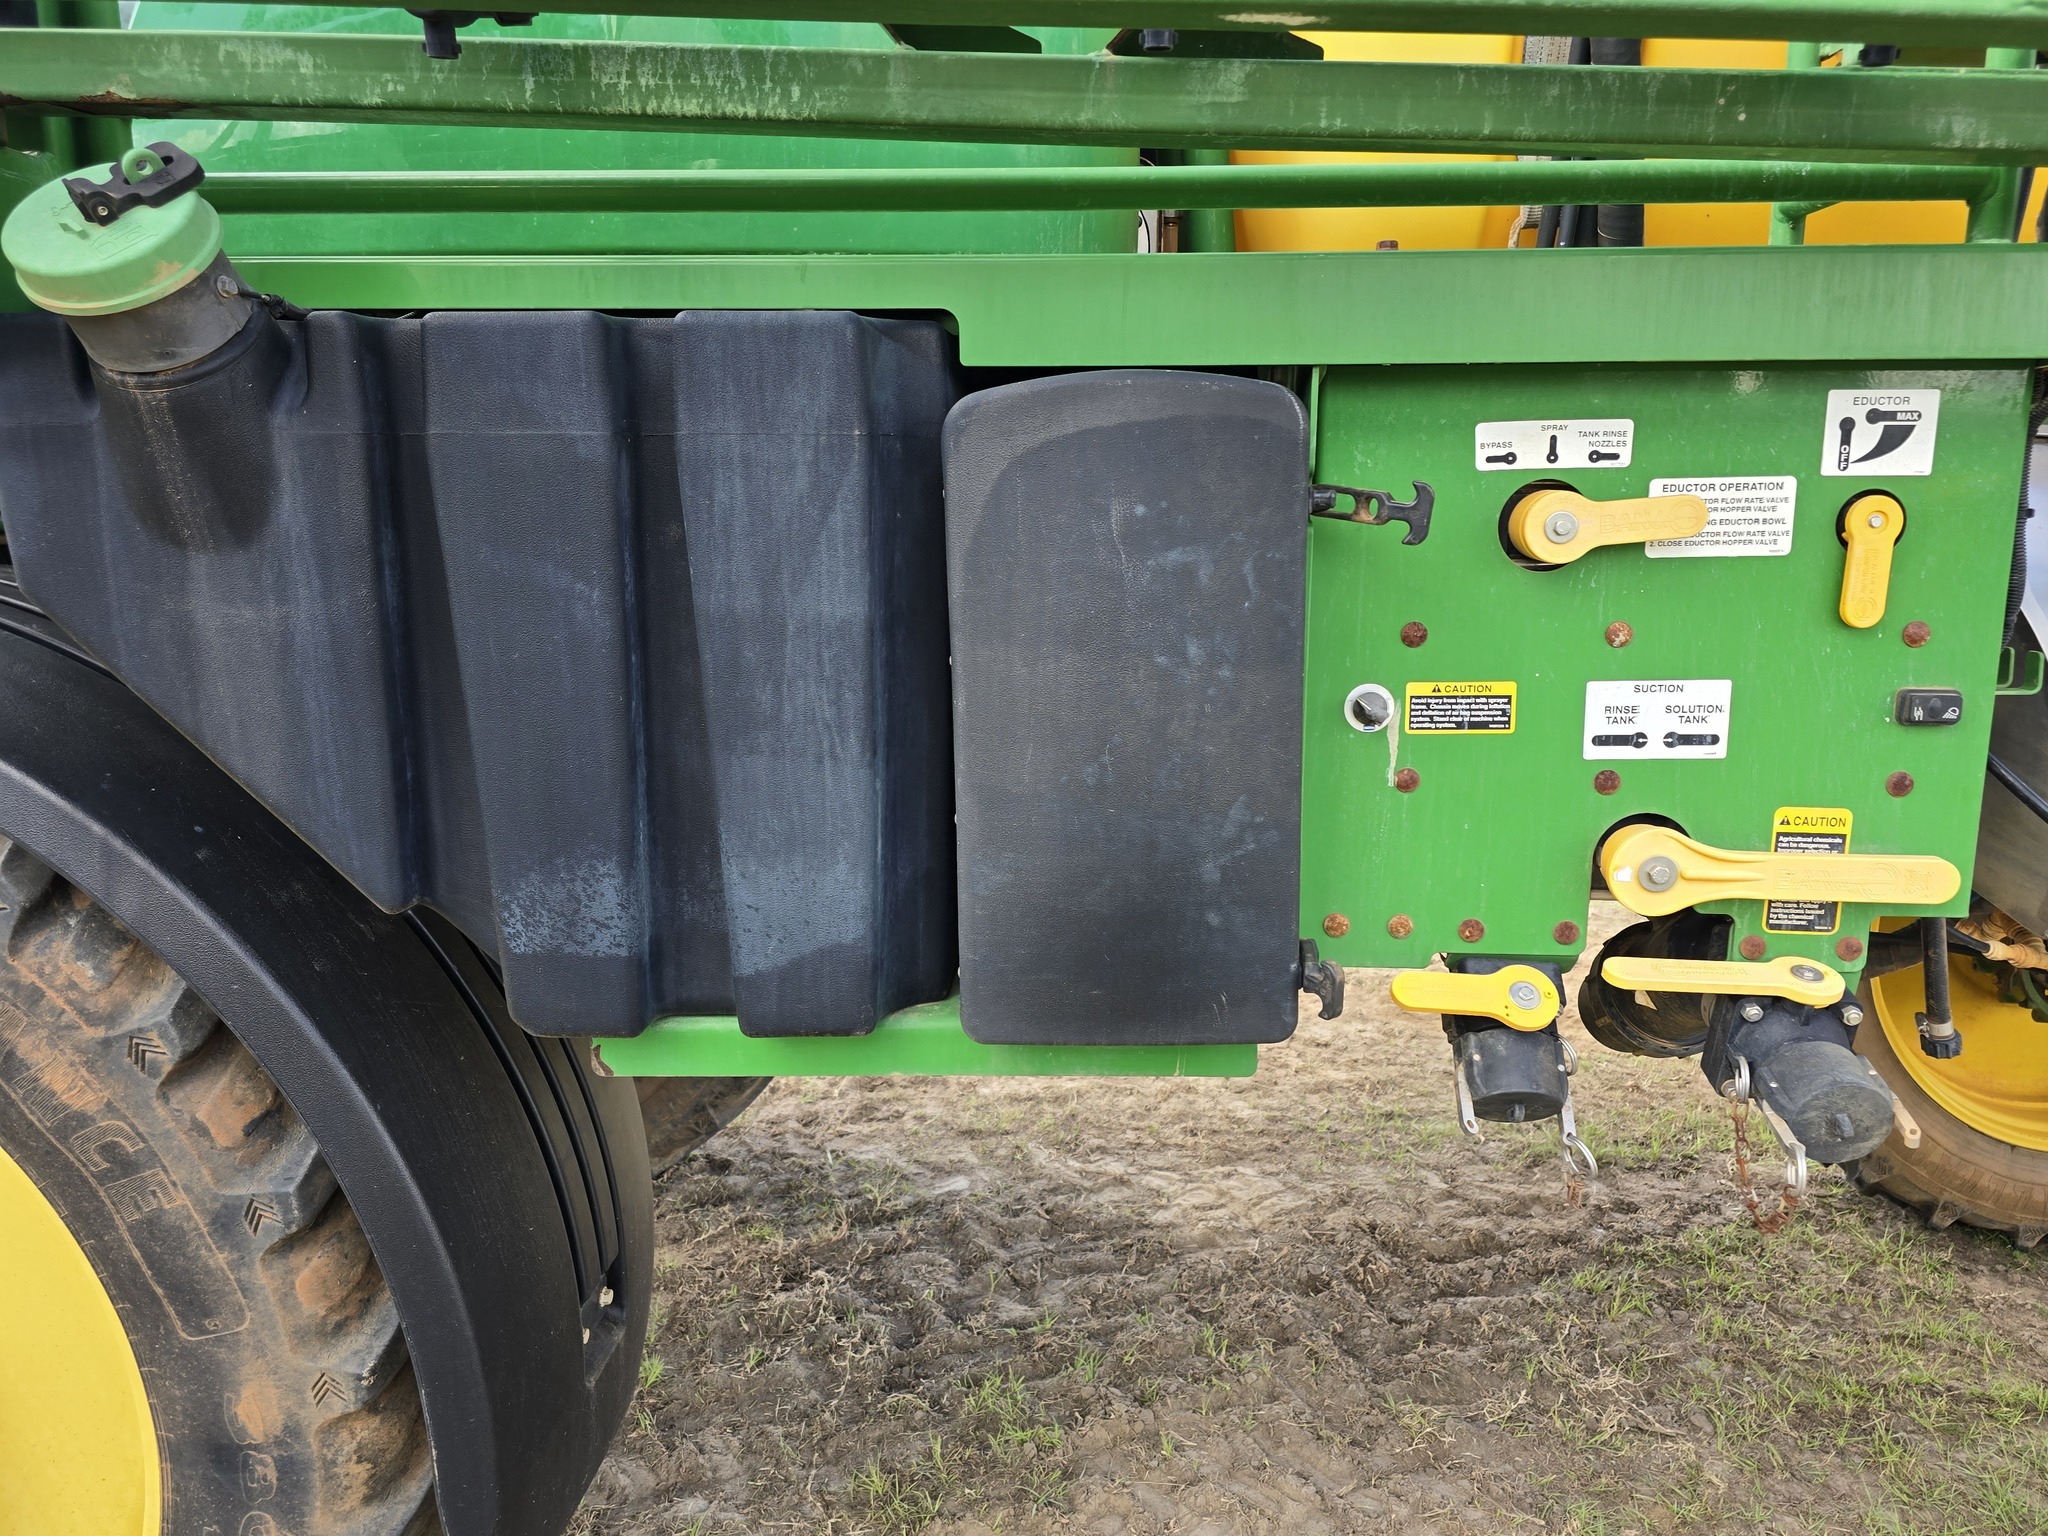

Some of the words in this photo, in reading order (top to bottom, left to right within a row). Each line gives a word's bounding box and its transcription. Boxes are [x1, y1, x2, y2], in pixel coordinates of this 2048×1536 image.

[1852, 397, 1910, 406] EDUCTOR
[1896, 412, 1920, 421] MAX
[1480, 442, 1513, 450] BYPASS
[1840, 446, 1850, 470] OFF
[1662, 484, 1716, 493] EDUCTOR
[1719, 482, 1784, 492] OPERATION
[1444, 684, 1492, 693] CAUTION
[1634, 684, 1684, 693] SUCTION
[1604, 705, 1640, 714] RINSE
[1665, 704, 1724, 714] SOLUTION
[1606, 716, 1636, 724] TANK
[1678, 716, 1708, 724] TANK
[1794, 816, 1846, 828] CAUTION
